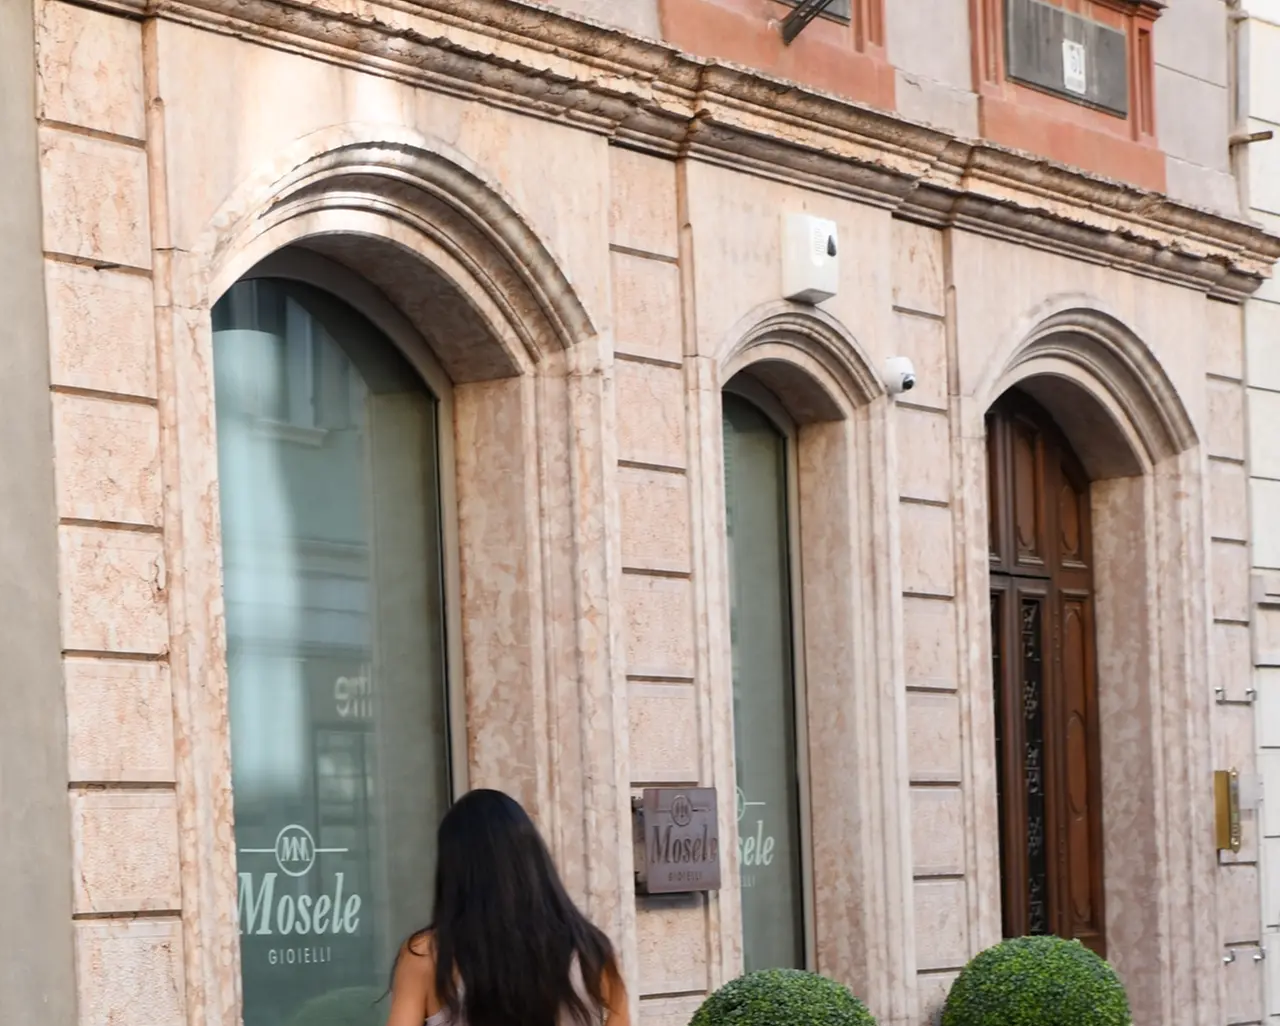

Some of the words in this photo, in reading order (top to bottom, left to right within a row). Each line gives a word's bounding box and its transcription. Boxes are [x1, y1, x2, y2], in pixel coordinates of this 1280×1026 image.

[651, 824, 718, 864] Mosele
[237, 872, 362, 935] Mosele
[268, 947, 331, 965] GIOIELLI
